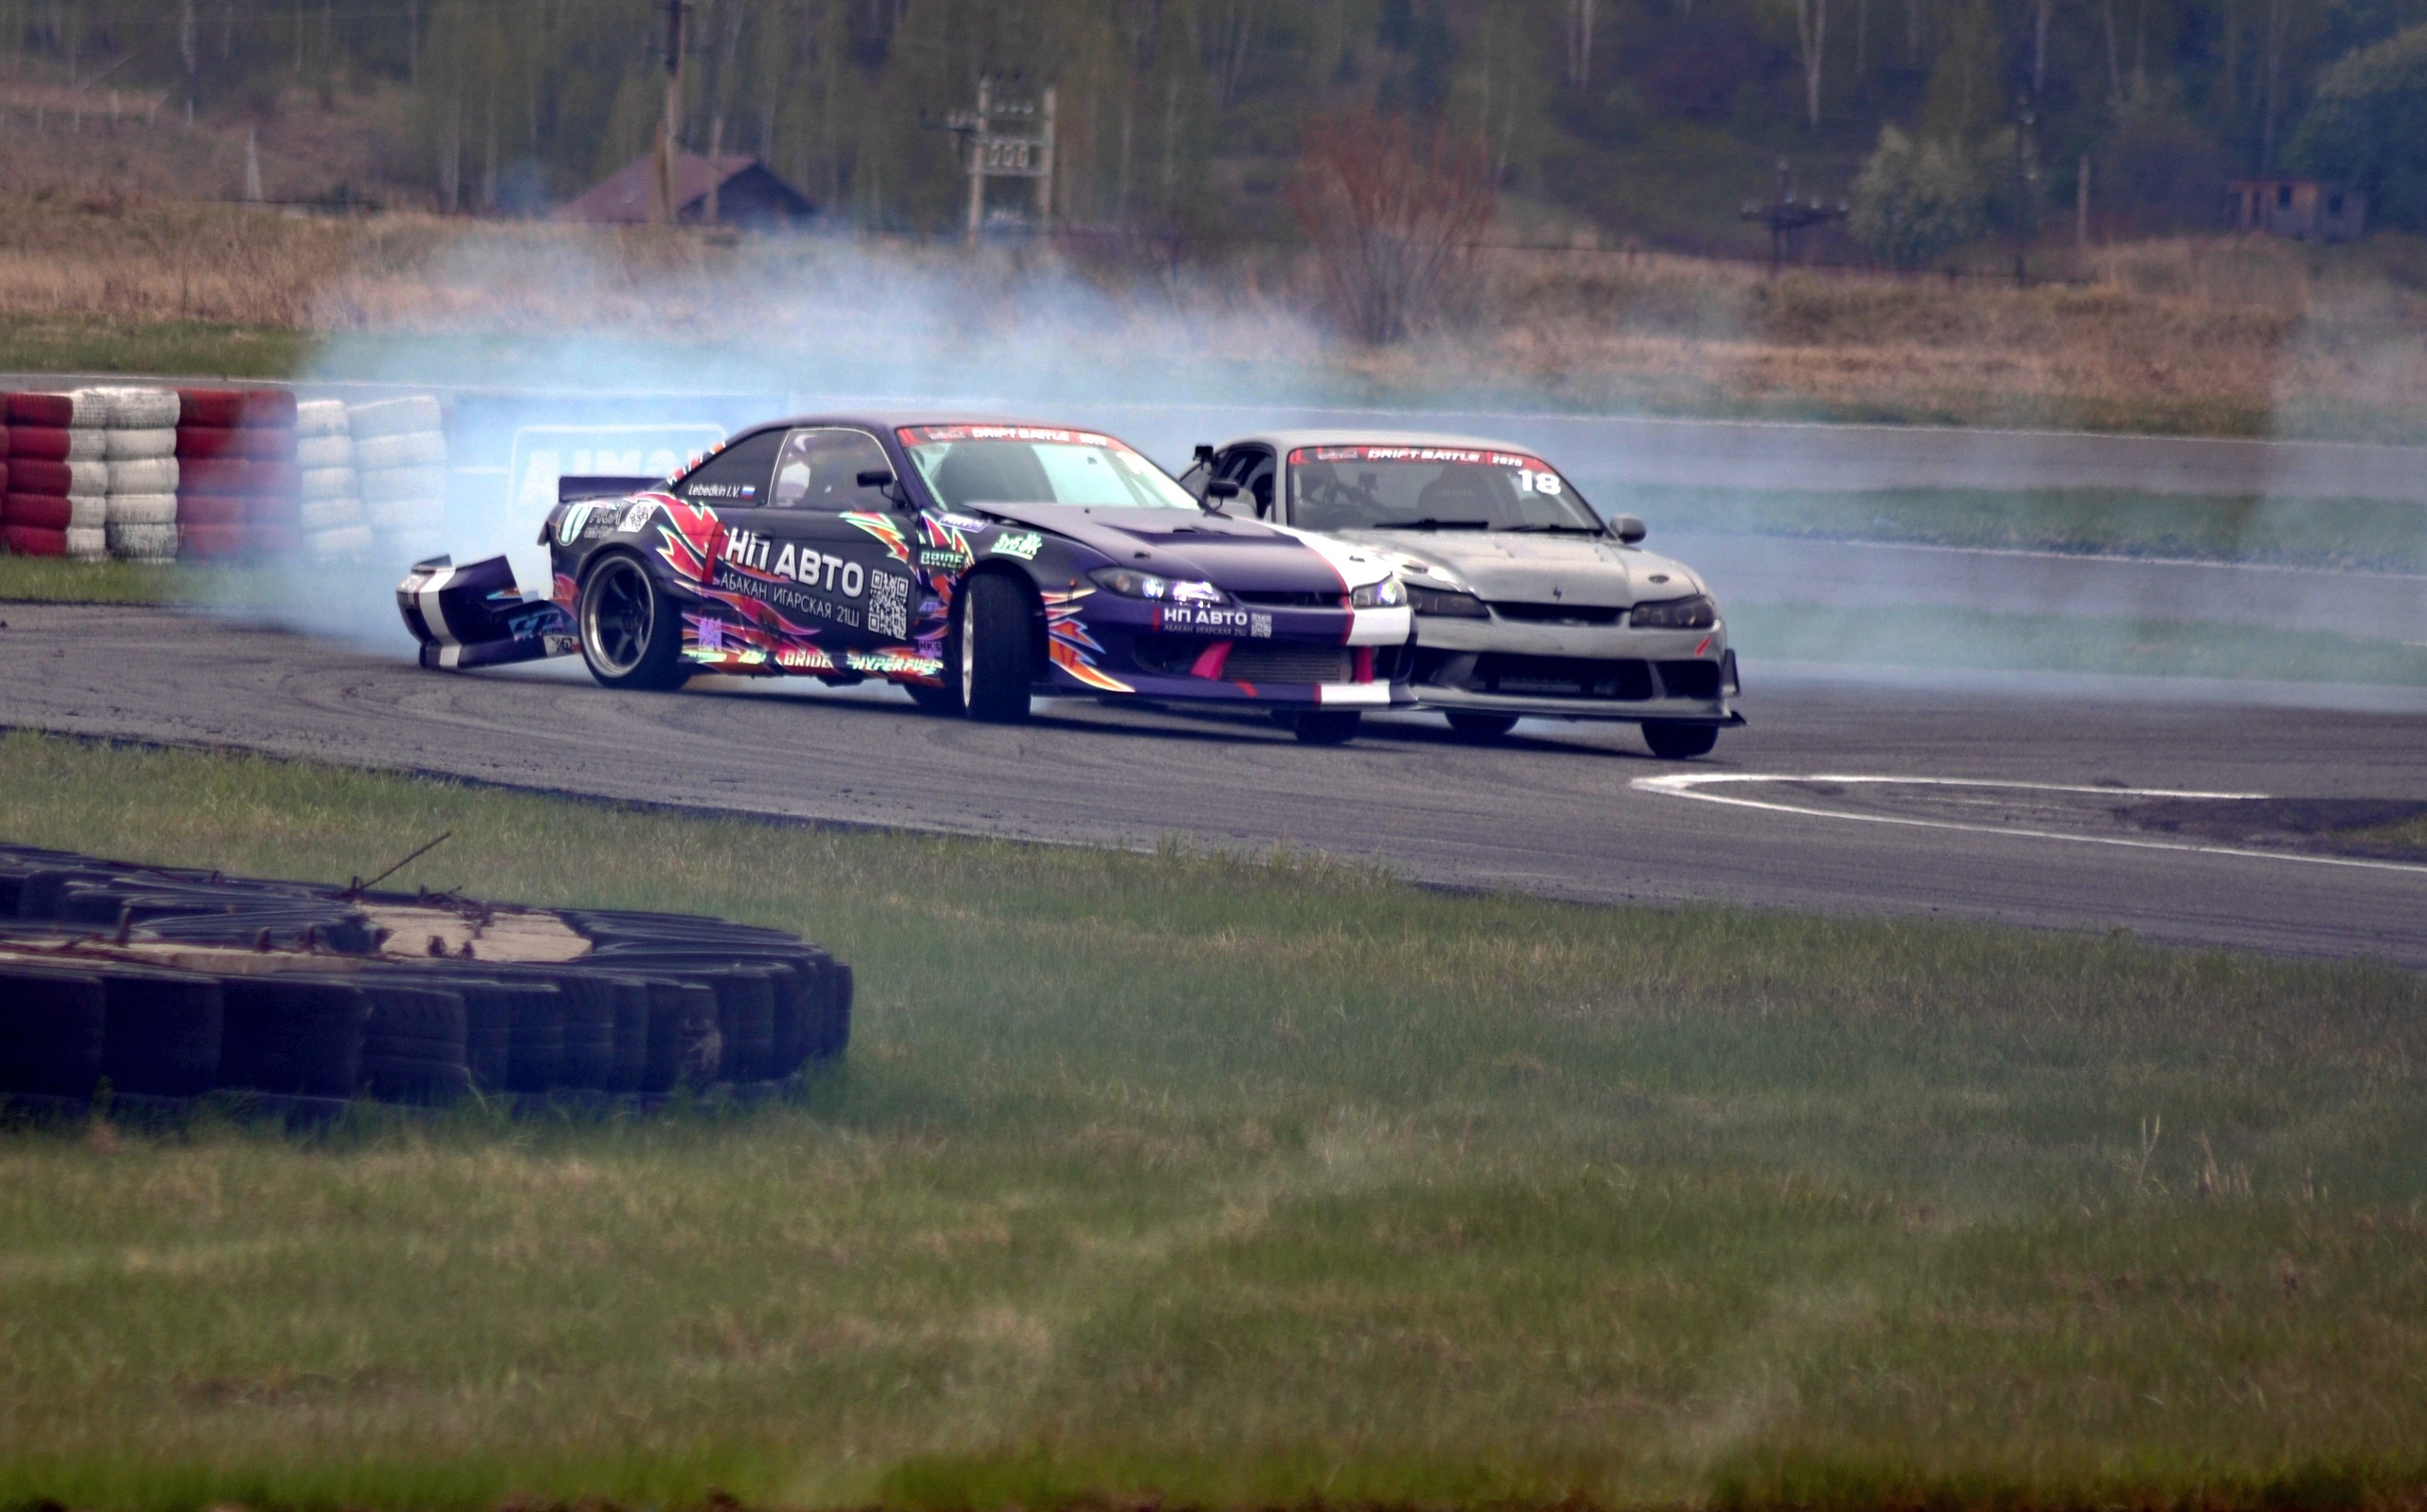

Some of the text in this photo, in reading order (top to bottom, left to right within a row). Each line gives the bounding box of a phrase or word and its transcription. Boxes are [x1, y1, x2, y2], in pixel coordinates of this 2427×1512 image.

[1368, 449, 1419, 459] DRIFT
[1421, 450, 1480, 462] BATTLE
[688, 483, 725, 497] Lebedkin
[1518, 469, 1560, 495] 18
[725, 528, 864, 597] НП АВТО
[721, 572, 767, 599] АБАКАН
[774, 587, 831, 619] ИГАРСКАЯ
[1164, 608, 1248, 626] НП АВТО
[920, 642, 941, 652] HKS
